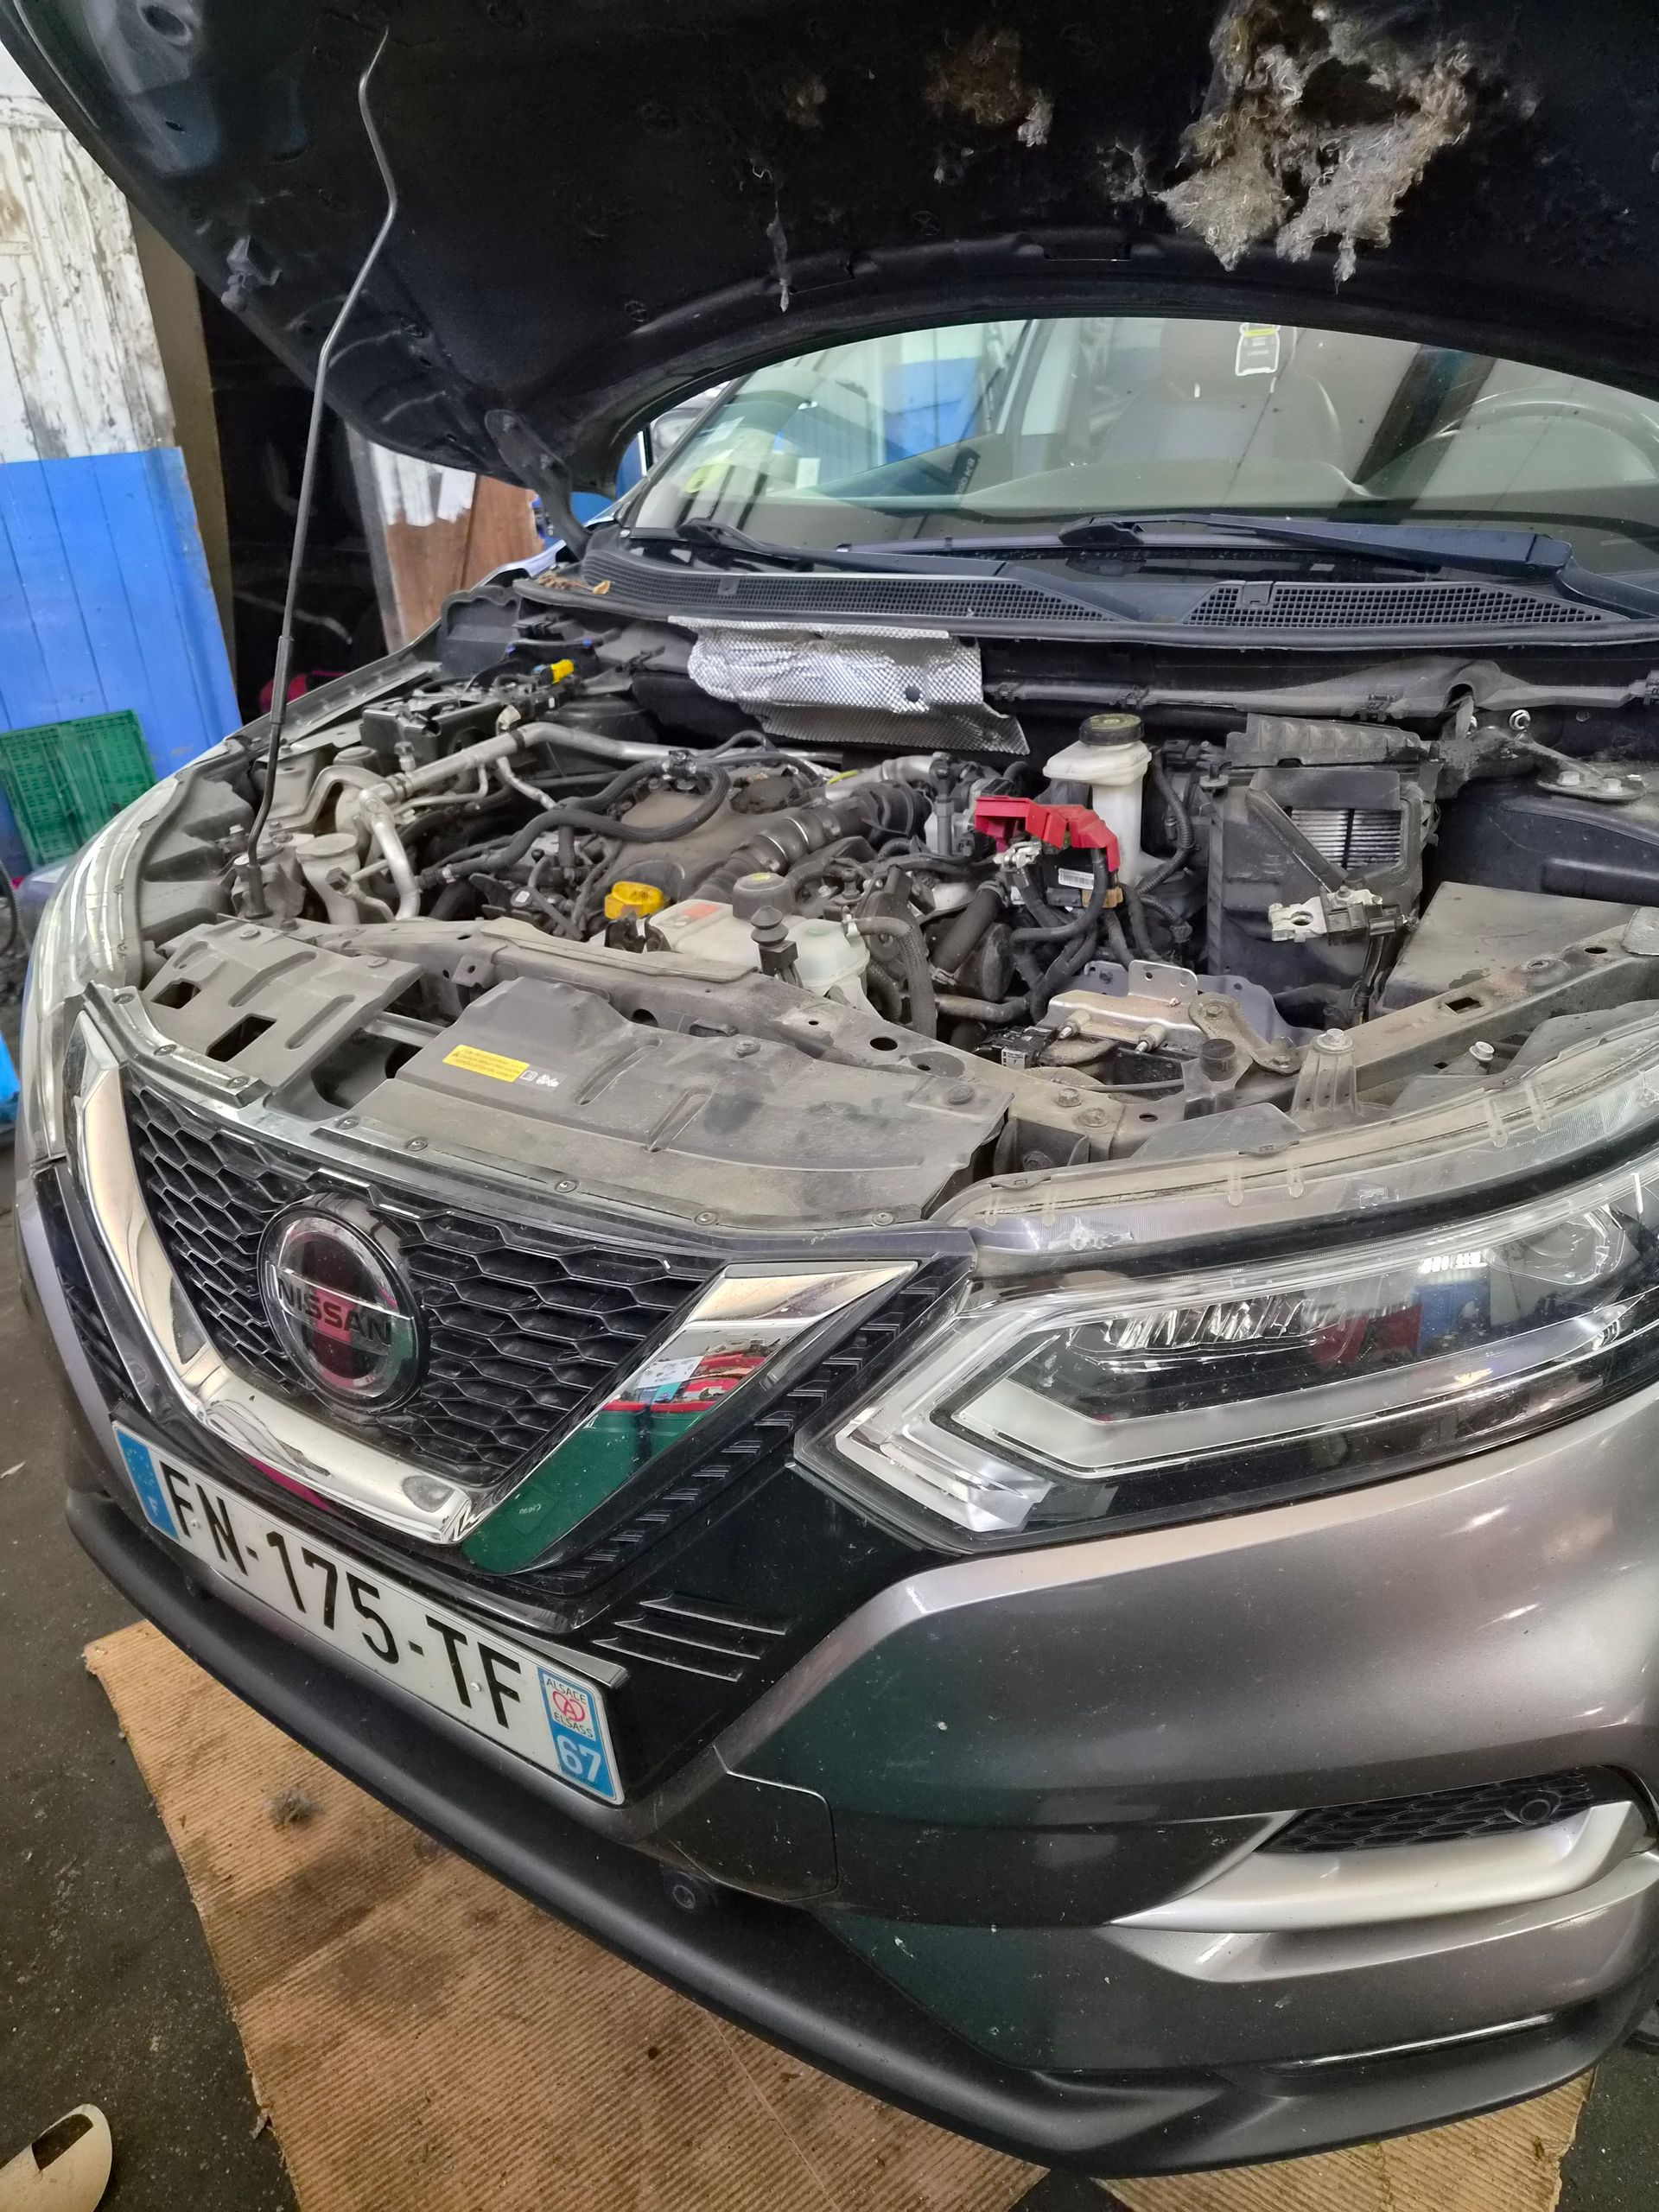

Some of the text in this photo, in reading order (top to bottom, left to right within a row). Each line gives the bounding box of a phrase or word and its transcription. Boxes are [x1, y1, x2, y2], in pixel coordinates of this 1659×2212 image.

[278, 1274, 393, 1346] NISSAN
[160, 1460, 521, 1729] FN-175-TF
[546, 1678, 587, 1704] ALSACE
[554, 1712, 594, 1738] ELSASS
[556, 1734, 601, 1783] 67
